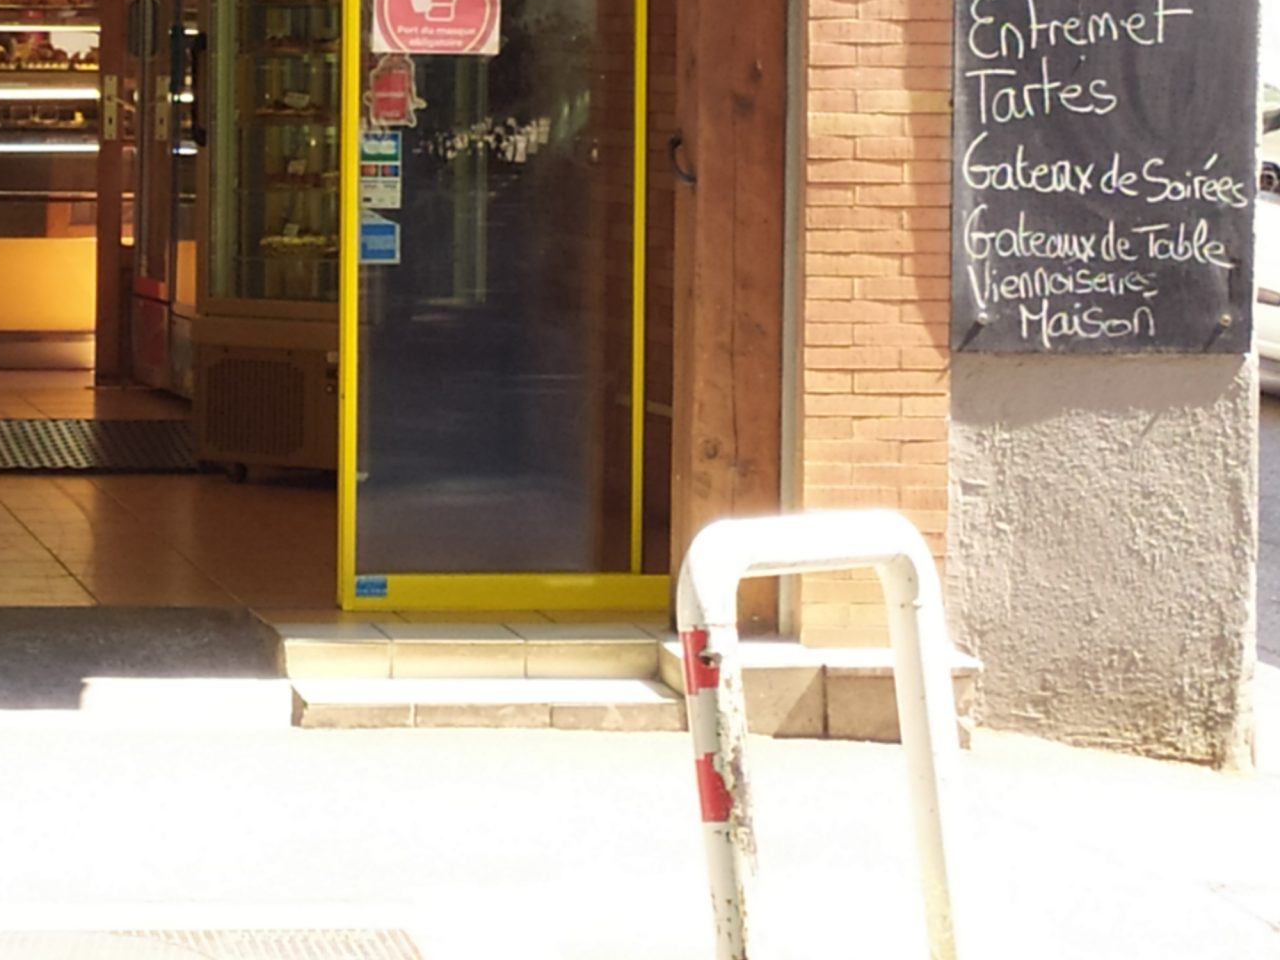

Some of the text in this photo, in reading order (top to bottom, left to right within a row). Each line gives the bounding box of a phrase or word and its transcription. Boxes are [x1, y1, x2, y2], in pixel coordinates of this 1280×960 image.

[965, 56, 1117, 124] Tartes
[1100, 152, 1139, 196] de
[1142, 153, 1248, 208] Soirées
[964, 204, 1236, 269] Gateaux de Table
[1019, 298, 1156, 348] Maison
